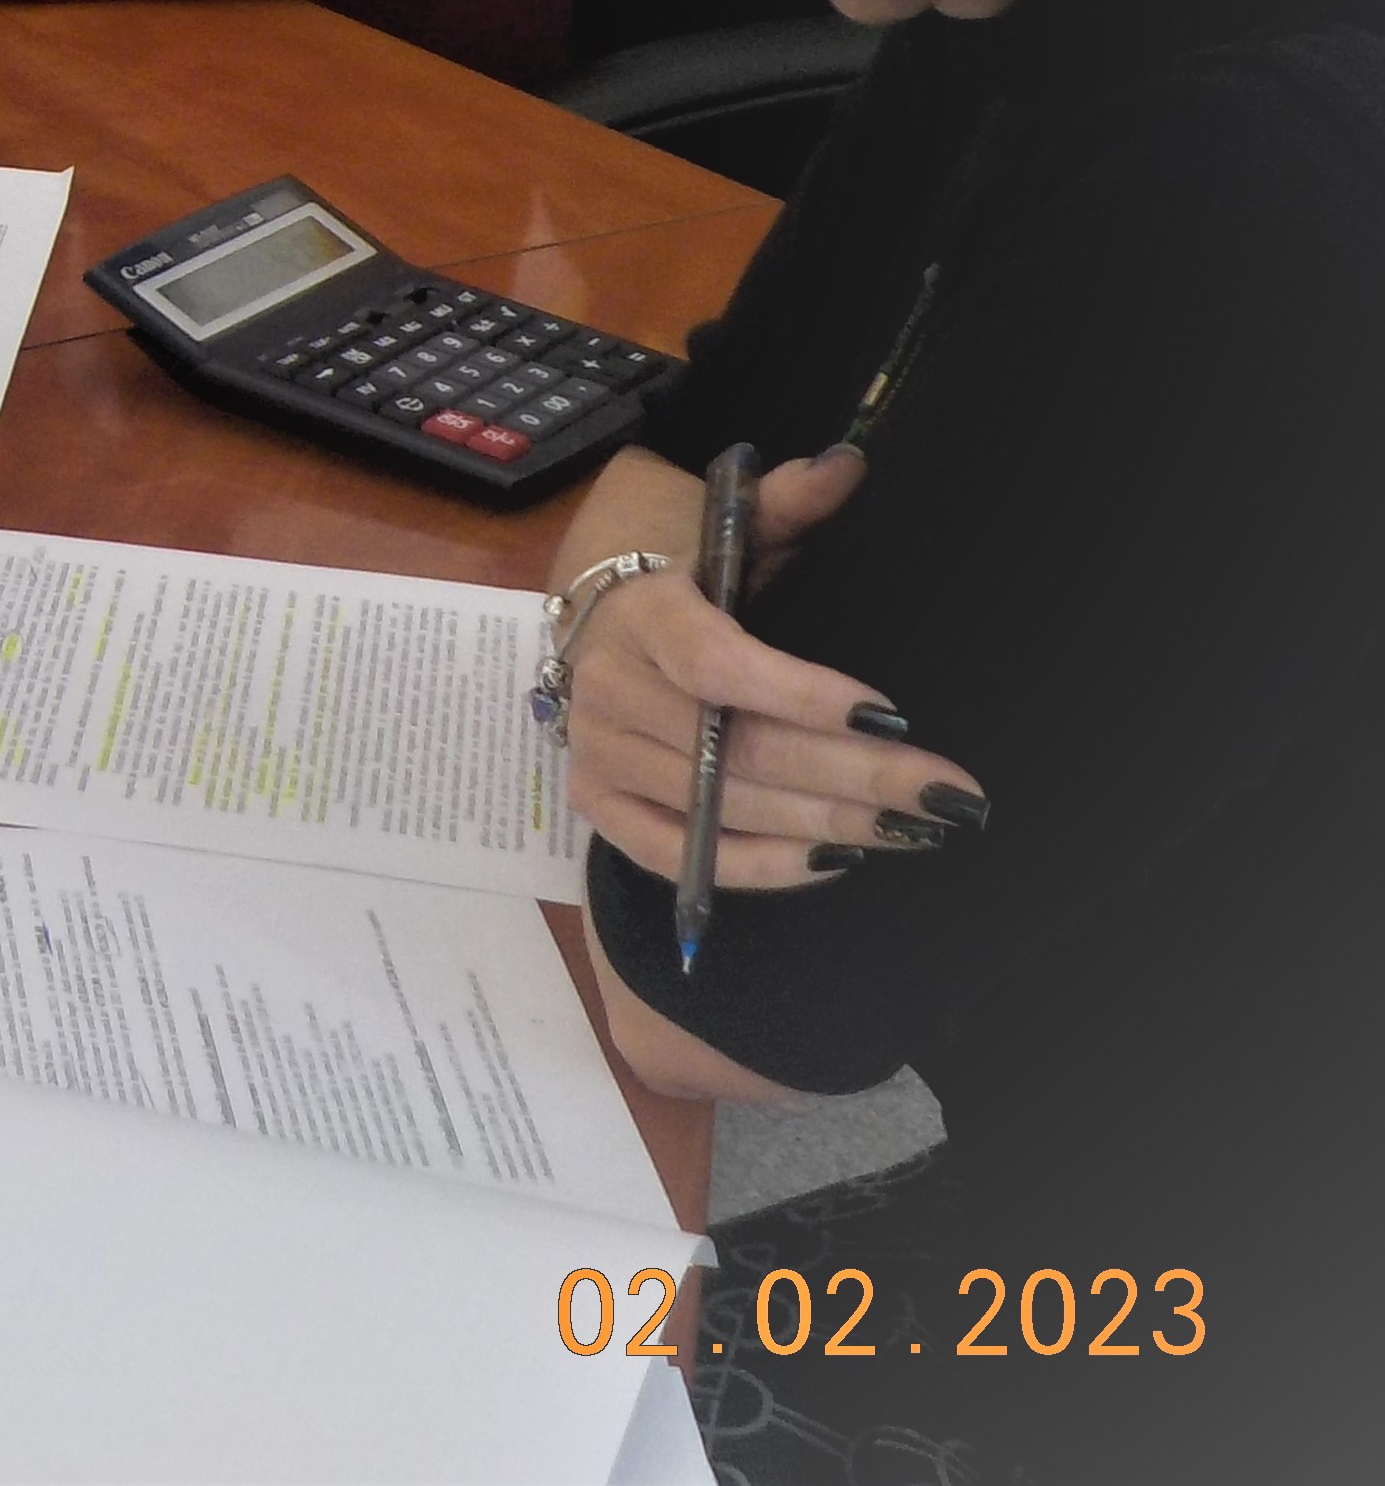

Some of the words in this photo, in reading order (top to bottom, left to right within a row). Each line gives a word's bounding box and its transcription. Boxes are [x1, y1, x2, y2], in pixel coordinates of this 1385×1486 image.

[120, 251, 174, 281] Canon
[388, 367, 406, 378] 7
[417, 351, 437, 363] 8
[442, 337, 463, 349] 9
[434, 381, 454, 392] 4
[459, 366, 480, 378] 5
[485, 352, 506, 364] 6
[478, 398, 496, 408] 1
[502, 383, 524, 394] 2
[528, 367, 550, 379] 3
[543, 395, 571, 411] 00
